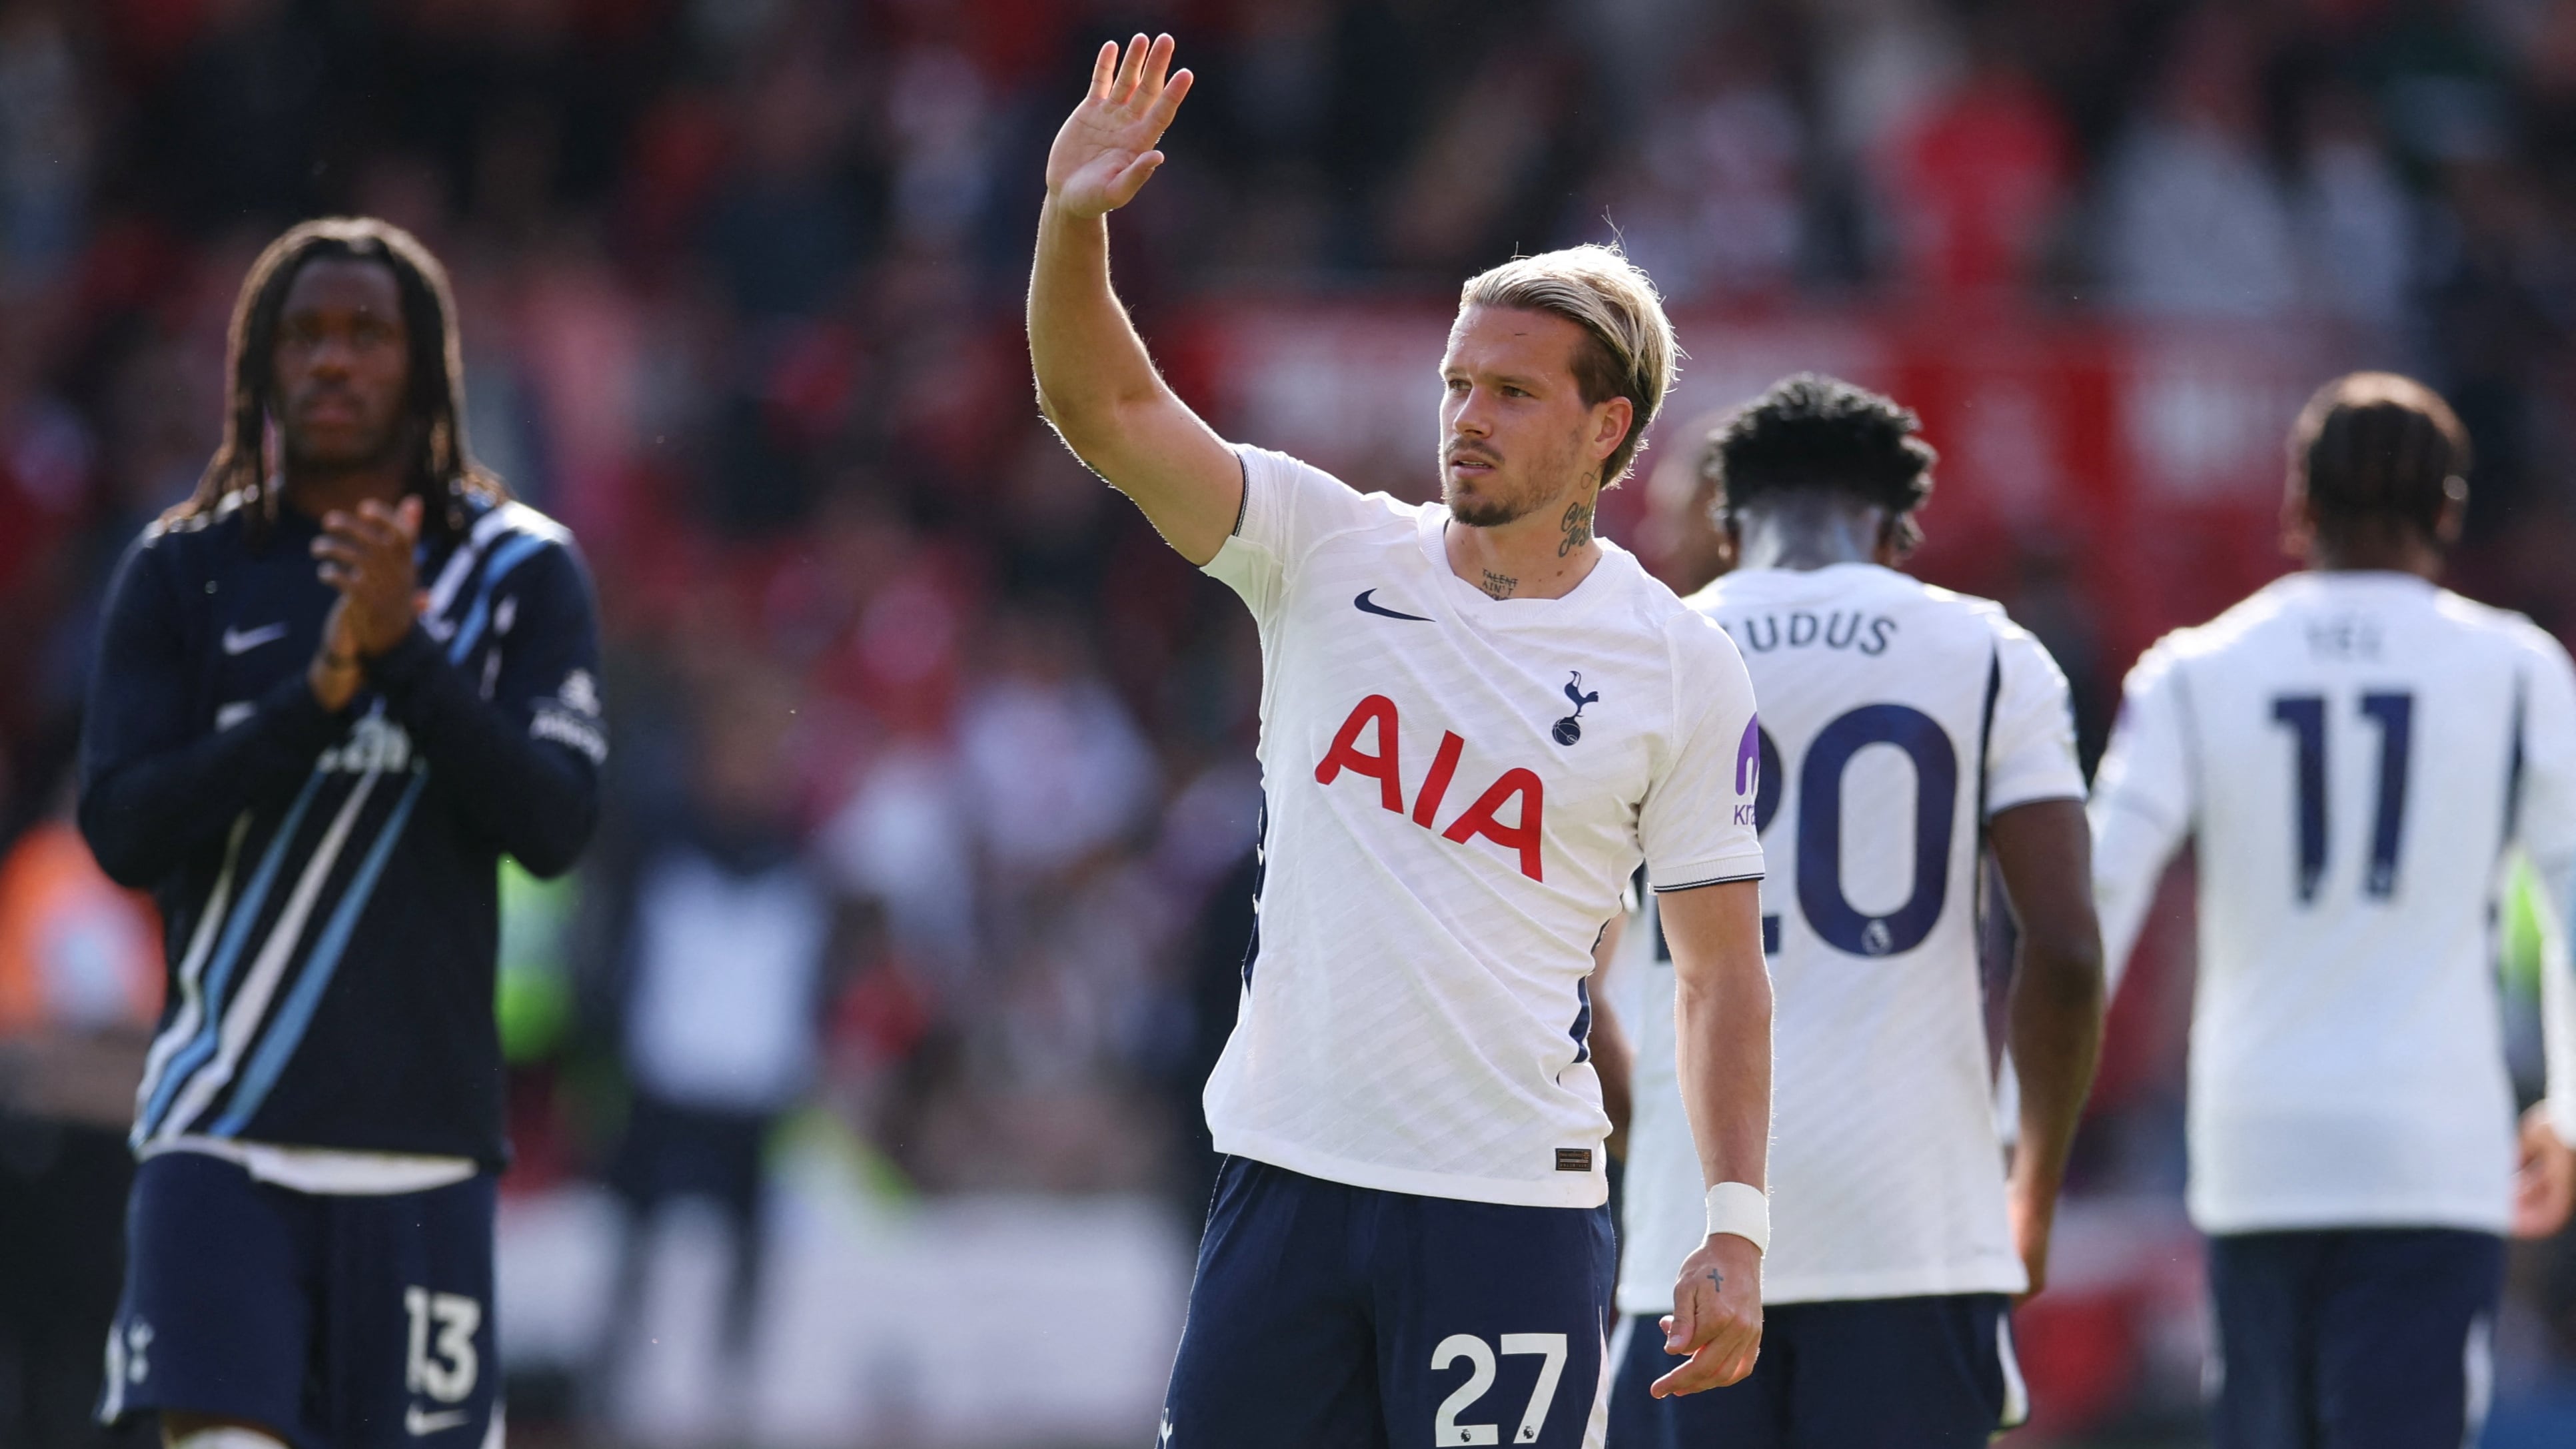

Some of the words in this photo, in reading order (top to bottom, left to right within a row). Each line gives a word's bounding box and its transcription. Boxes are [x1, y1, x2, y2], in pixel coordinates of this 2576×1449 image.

[1720, 611, 1898, 656] UDUS
[1315, 694, 1543, 883] AIA
[2269, 690, 2415, 905] 11
[404, 1286, 481, 1401] 13
[1431, 1333, 1568, 1448] 27
